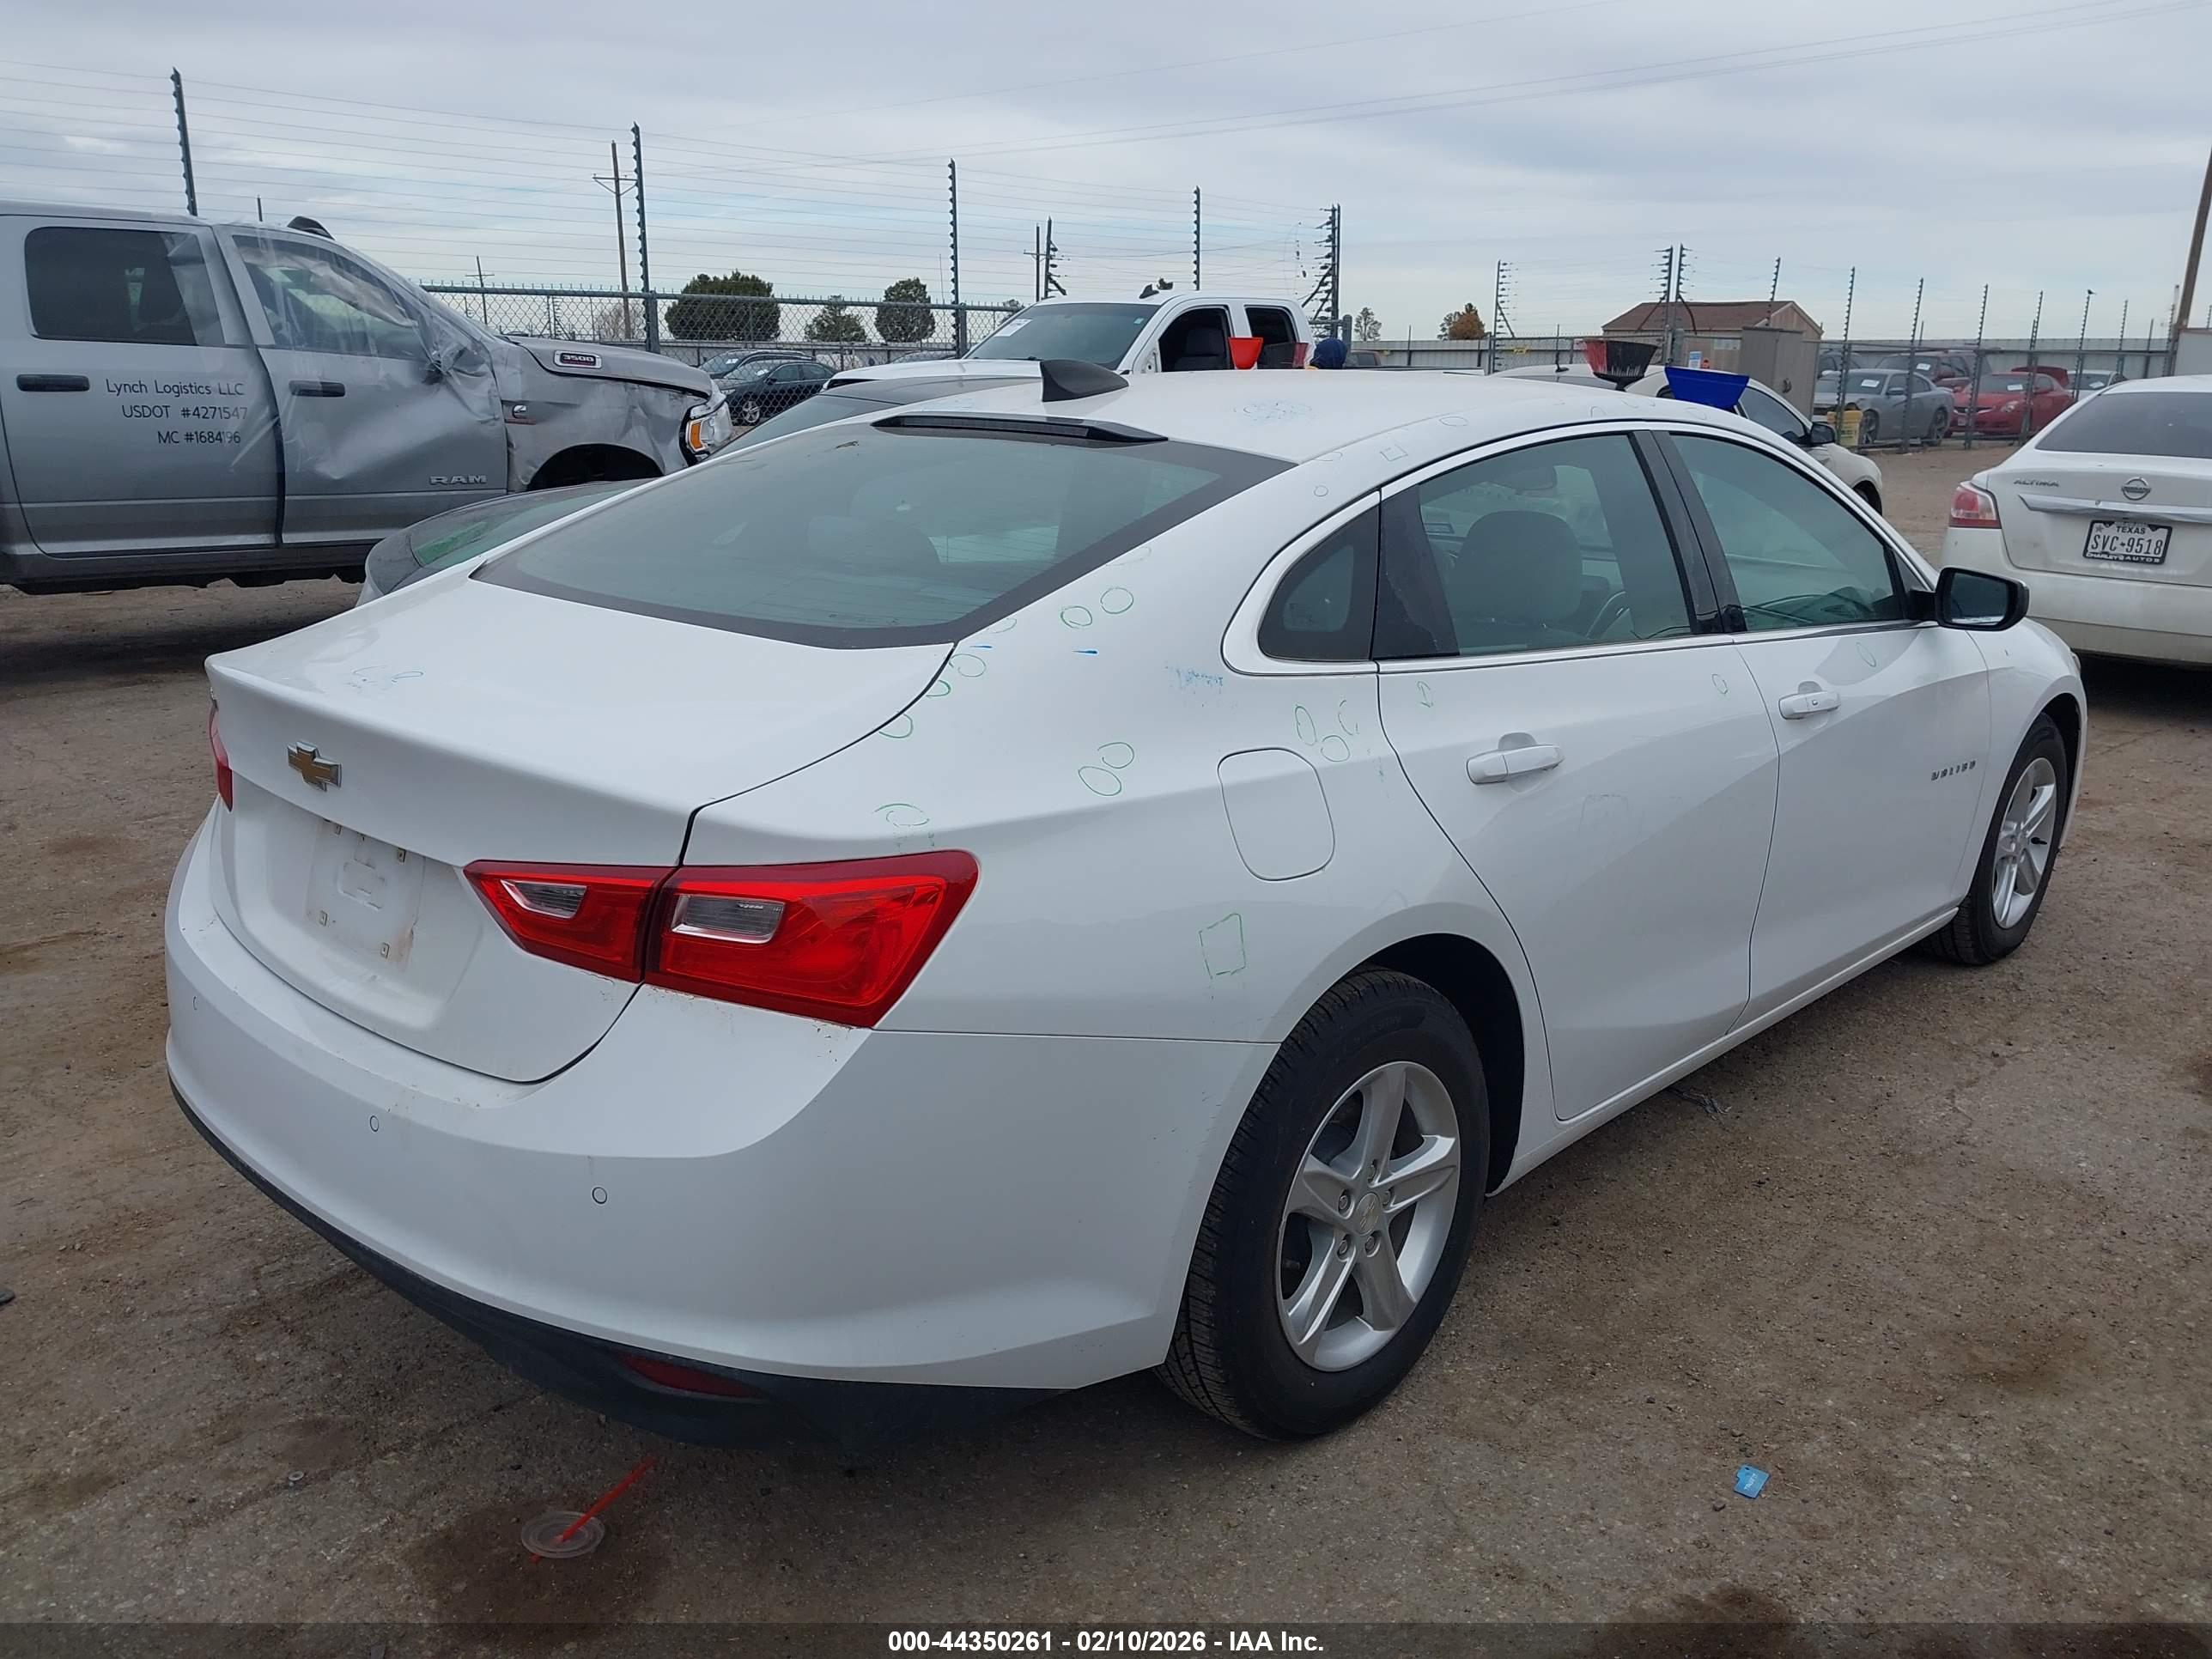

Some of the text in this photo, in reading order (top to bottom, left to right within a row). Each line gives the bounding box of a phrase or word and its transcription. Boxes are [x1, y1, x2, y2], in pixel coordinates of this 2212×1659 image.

[562, 354, 594, 362] 3500
[106, 379, 246, 398] Lynch Logistics LLC
[122, 405, 248, 420] USDOT #4271547
[157, 430, 241, 445] MC #1684196
[430, 475, 487, 485] RAM
[2117, 526, 2147, 535] TEXAS
